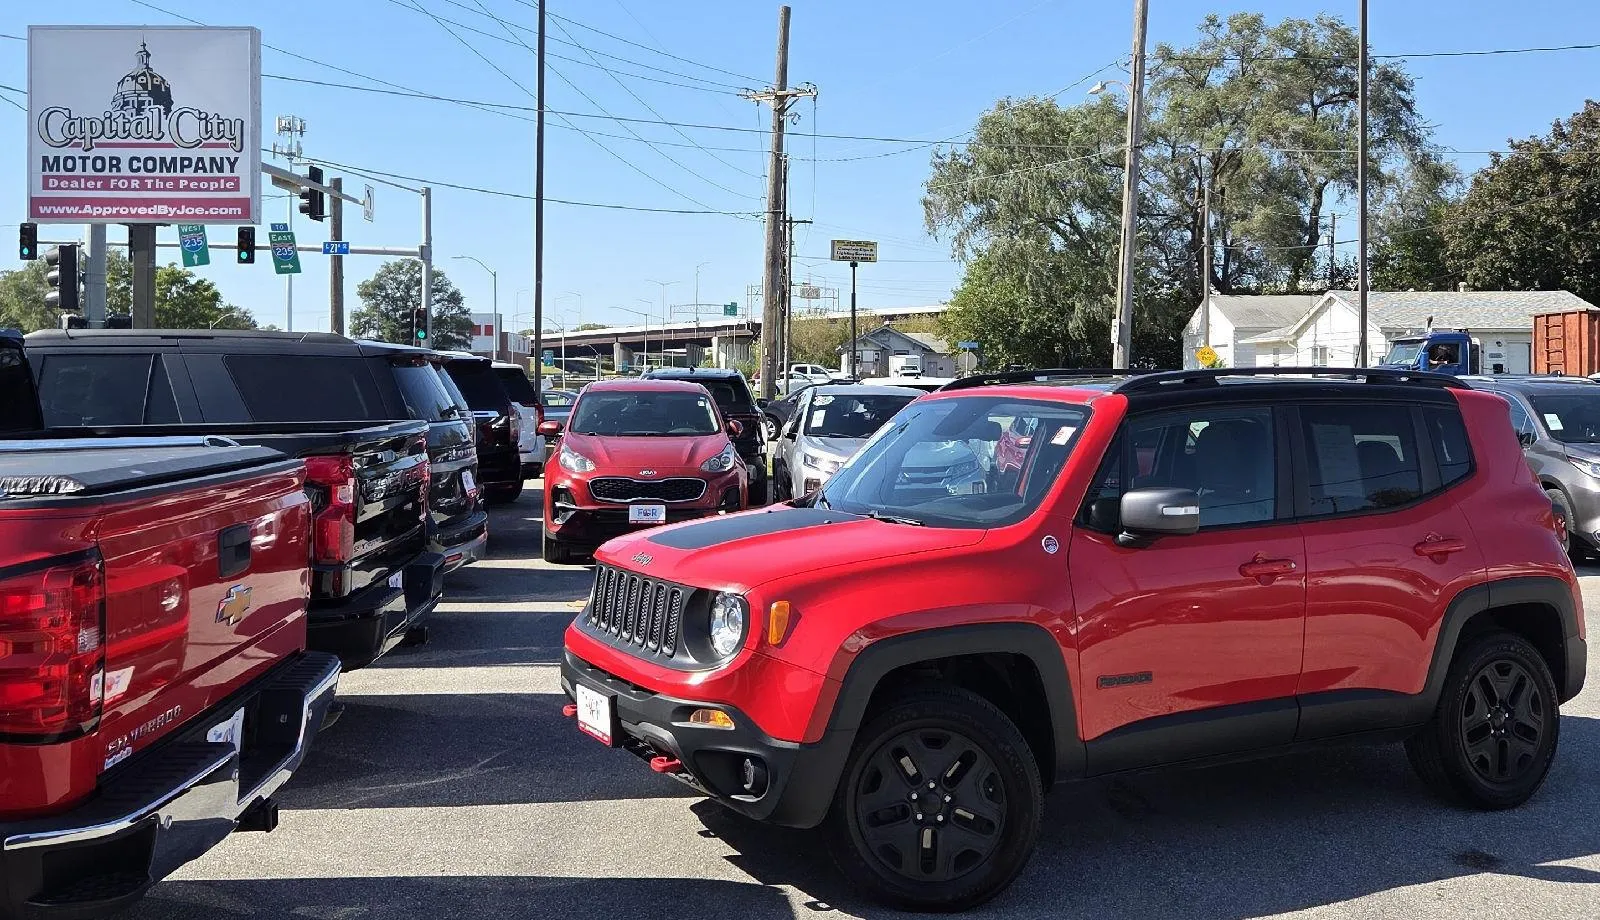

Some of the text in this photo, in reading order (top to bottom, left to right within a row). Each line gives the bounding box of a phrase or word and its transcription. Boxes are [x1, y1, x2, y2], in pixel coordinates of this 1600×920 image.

[38, 106, 244, 152] Capital City
[42, 155, 240, 174] MOTOR COMPANY
[49, 178, 236, 191] Dealer FOR The People
[38, 204, 242, 216] www.ApprovedByJoe.com
[184, 238, 203, 248] 235
[271, 234, 292, 242] EAST
[275, 247, 294, 256] 235
